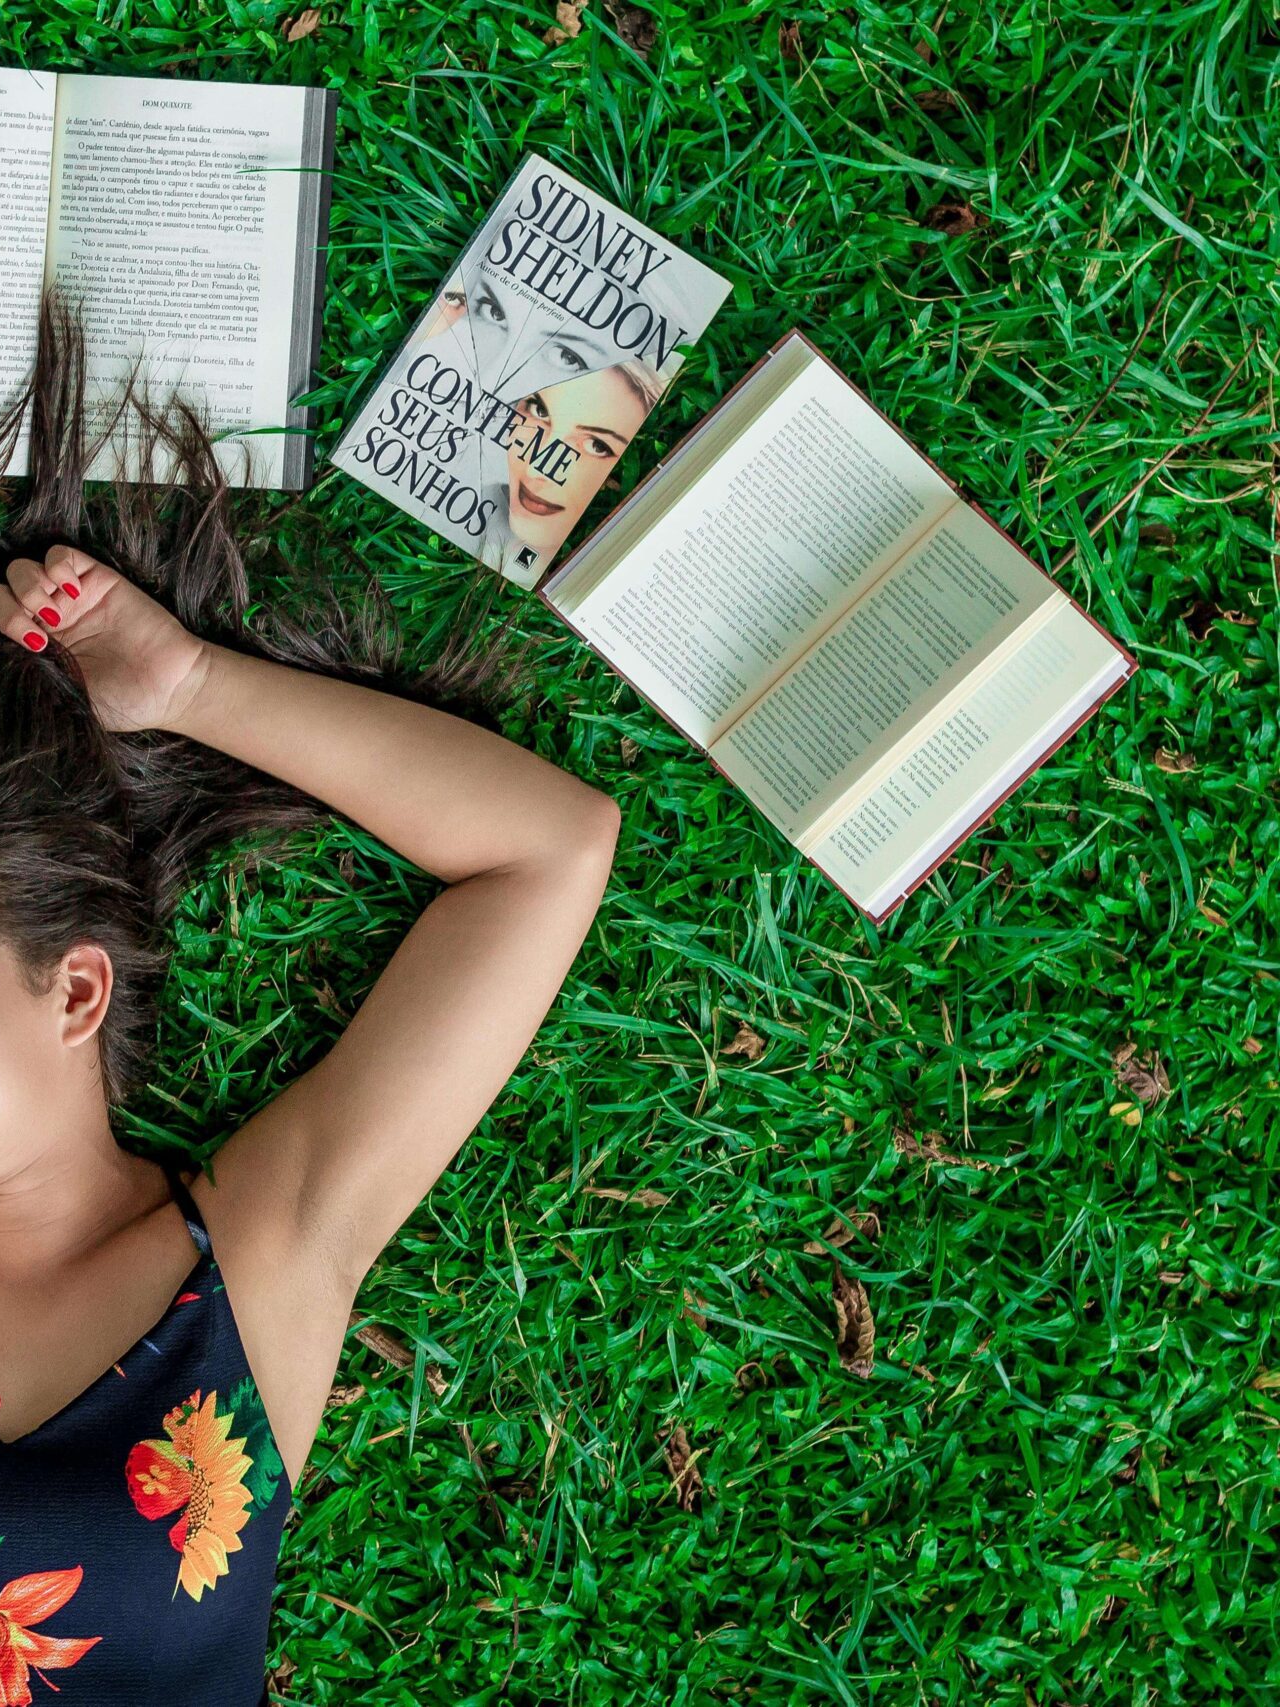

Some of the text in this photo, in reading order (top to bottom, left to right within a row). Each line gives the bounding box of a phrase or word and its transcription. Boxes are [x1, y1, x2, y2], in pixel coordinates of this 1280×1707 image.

[159, 101, 191, 109] QUIXOTE
[73, 117, 88, 126] dizer
[108, 119, 143, 131] Cardênio,
[142, 121, 162, 130] desde
[163, 122, 185, 133] aquela
[186, 124, 210, 133] fatídica
[212, 125, 247, 137] cerimônia,
[247, 130, 269, 138] vagava
[111, 129, 128, 138] nada
[128, 133, 141, 141] que
[142, 134, 167, 142] pusesse
[168, 133, 180, 141] fim
[198, 134, 212, 143] dor.
[85, 141, 103, 152] padre
[103, 143, 125, 152] tentou
[125, 144, 156, 154] dizer-lhe
[157, 146, 184, 157] algumas
[185, 148, 211, 159] palavras
[211, 149, 220, 158] de
[220, 150, 248, 161] consolo,
[61, 171, 72, 180] Em
[73, 172, 100, 183] seguida,
[106, 174, 140, 186] camponês
[142, 176, 159, 185] tirou
[167, 180, 187, 189] capuz
[195, 179, 220, 189] sacudiu
[231, 181, 255, 191] cabelos
[257, 183, 266, 191] de
[515, 175, 671, 293] SIDNEY
[70, 251, 93, 263] Depois
[93, 253, 102, 261] de
[111, 254, 139, 265] acalmar,
[144, 258, 163, 267] moça
[164, 257, 203, 267] contou-lhes
[216, 260, 243, 270] história.
[242, 262, 261, 271] Cha-
[61, 271, 79, 282] pobre
[80, 272, 106, 282] donzela
[108, 274, 126, 283] havia
[137, 276, 175, 288] apaixonado
[177, 281, 188, 289] por
[190, 279, 209, 288] Dom
[211, 280, 245, 292] Fernando,
[245, 285, 261, 293] que,
[474, 259, 566, 324] Autor de O plano perfeito
[487, 220, 688, 373] SHELDON
[377, 390, 468, 463] SEUS
[406, 355, 581, 487] CONTE-ME
[353, 426, 498, 536] SONHOS
